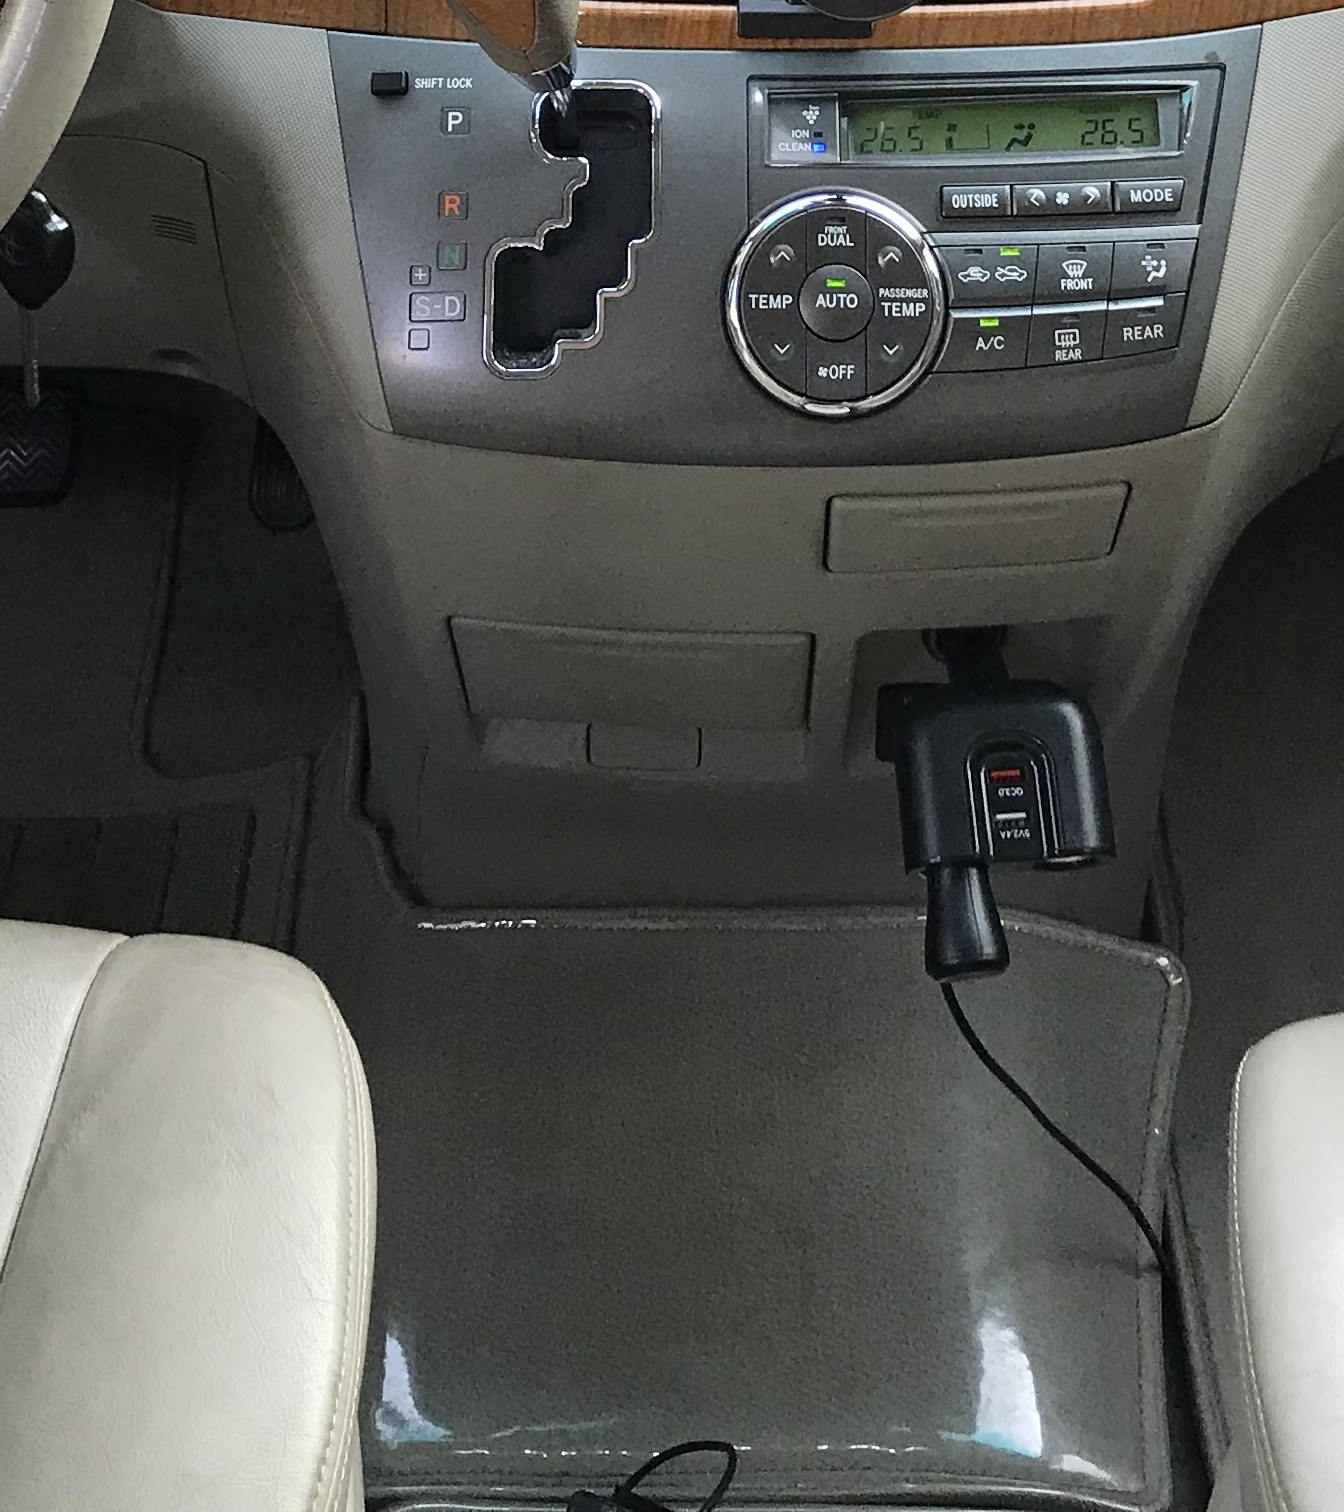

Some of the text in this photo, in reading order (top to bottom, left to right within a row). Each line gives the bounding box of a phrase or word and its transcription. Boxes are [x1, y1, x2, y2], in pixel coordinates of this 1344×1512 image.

[414, 77, 473, 89] SHIFT LOCK
[446, 112, 464, 132] P
[791, 129, 810, 139] ION
[1081, 117, 1144, 146] 26.5
[778, 142, 812, 152] CLEAN
[951, 192, 999, 209] OUTSIDE
[1129, 188, 1174, 204] MODE
[444, 194, 460, 216] R
[823, 225, 848, 234] FRONT
[817, 233, 855, 248] DUAL
[1059, 277, 1094, 291] FRONT
[749, 293, 793, 310] TEMP
[815, 293, 858, 309] AUTO
[878, 288, 929, 299] PASSENGER
[881, 302, 926, 319] TEMP
[1122, 324, 1164, 342] REAR
[975, 335, 1005, 352] A/C
[1055, 348, 1082, 361] REAR
[828, 365, 855, 380] OFF
